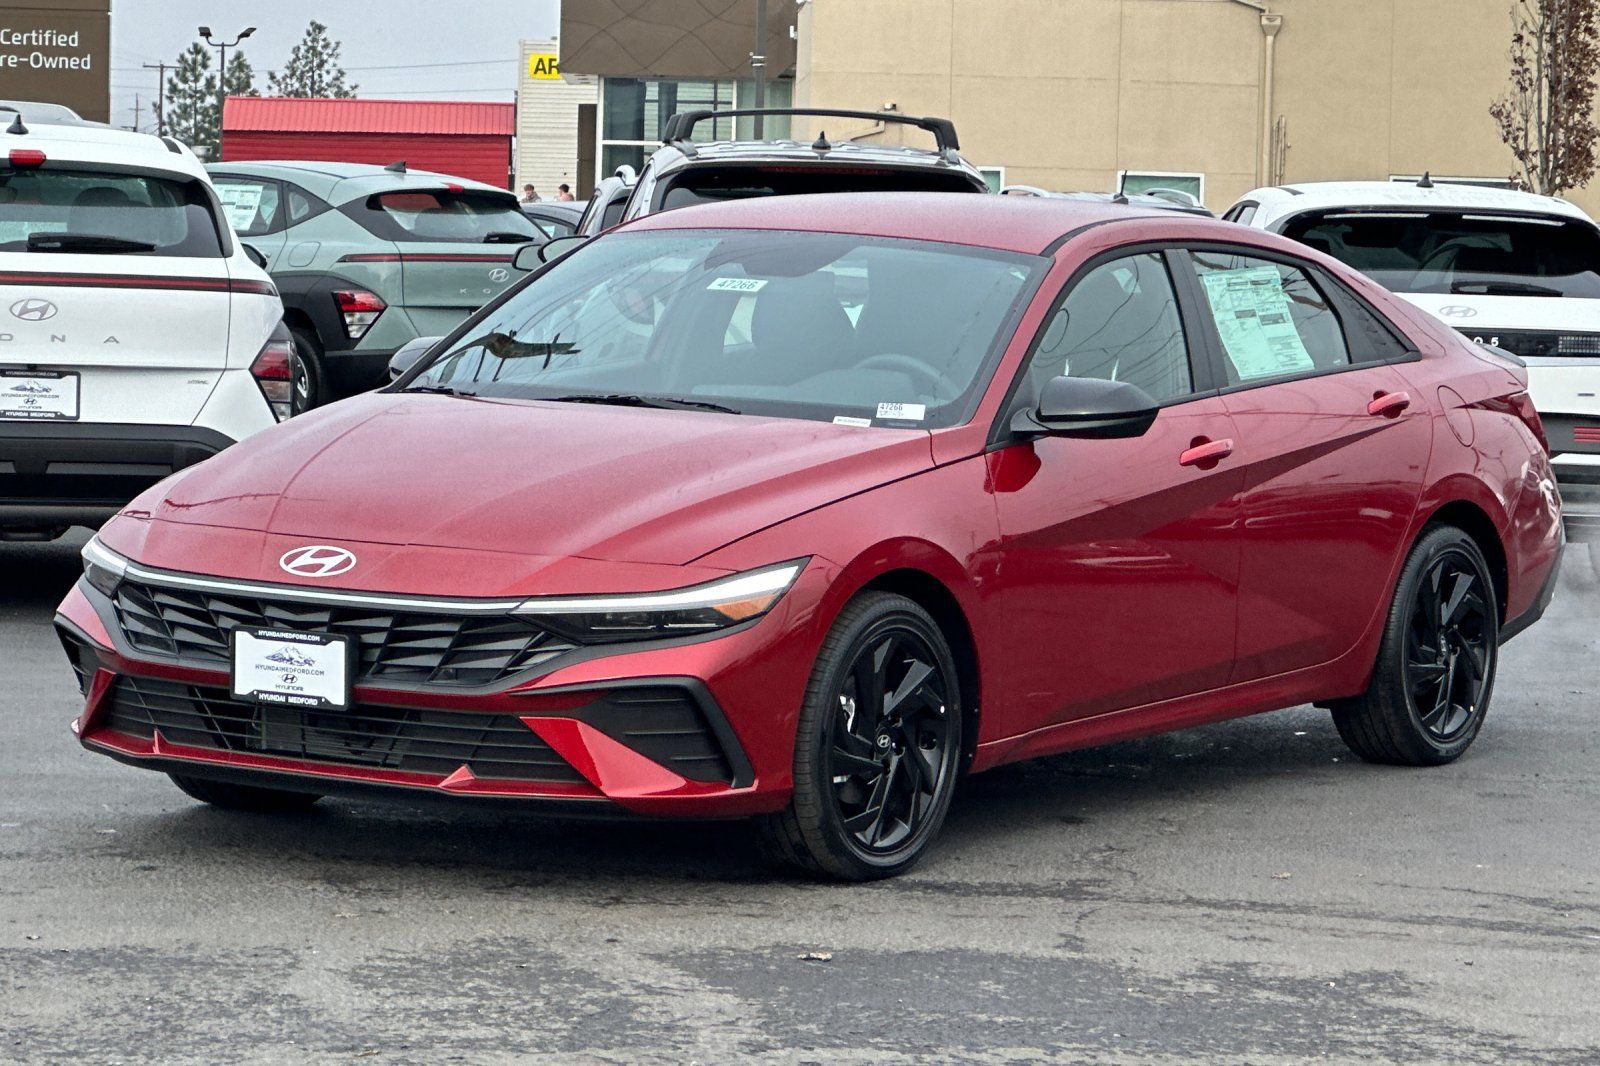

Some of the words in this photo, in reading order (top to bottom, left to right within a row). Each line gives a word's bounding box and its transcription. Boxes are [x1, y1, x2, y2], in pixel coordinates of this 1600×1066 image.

[0, 28, 79, 47] Certified
[717, 279, 758, 290] 47266
[880, 402, 903, 411] 47266
[258, 630, 320, 641] HYUNDAIMEDFORD.COM
[255, 664, 325, 676] HYUNDAIMEDFORD.COM
[259, 693, 286, 702] HYUNDAI
[288, 696, 318, 706] MEDFORD
